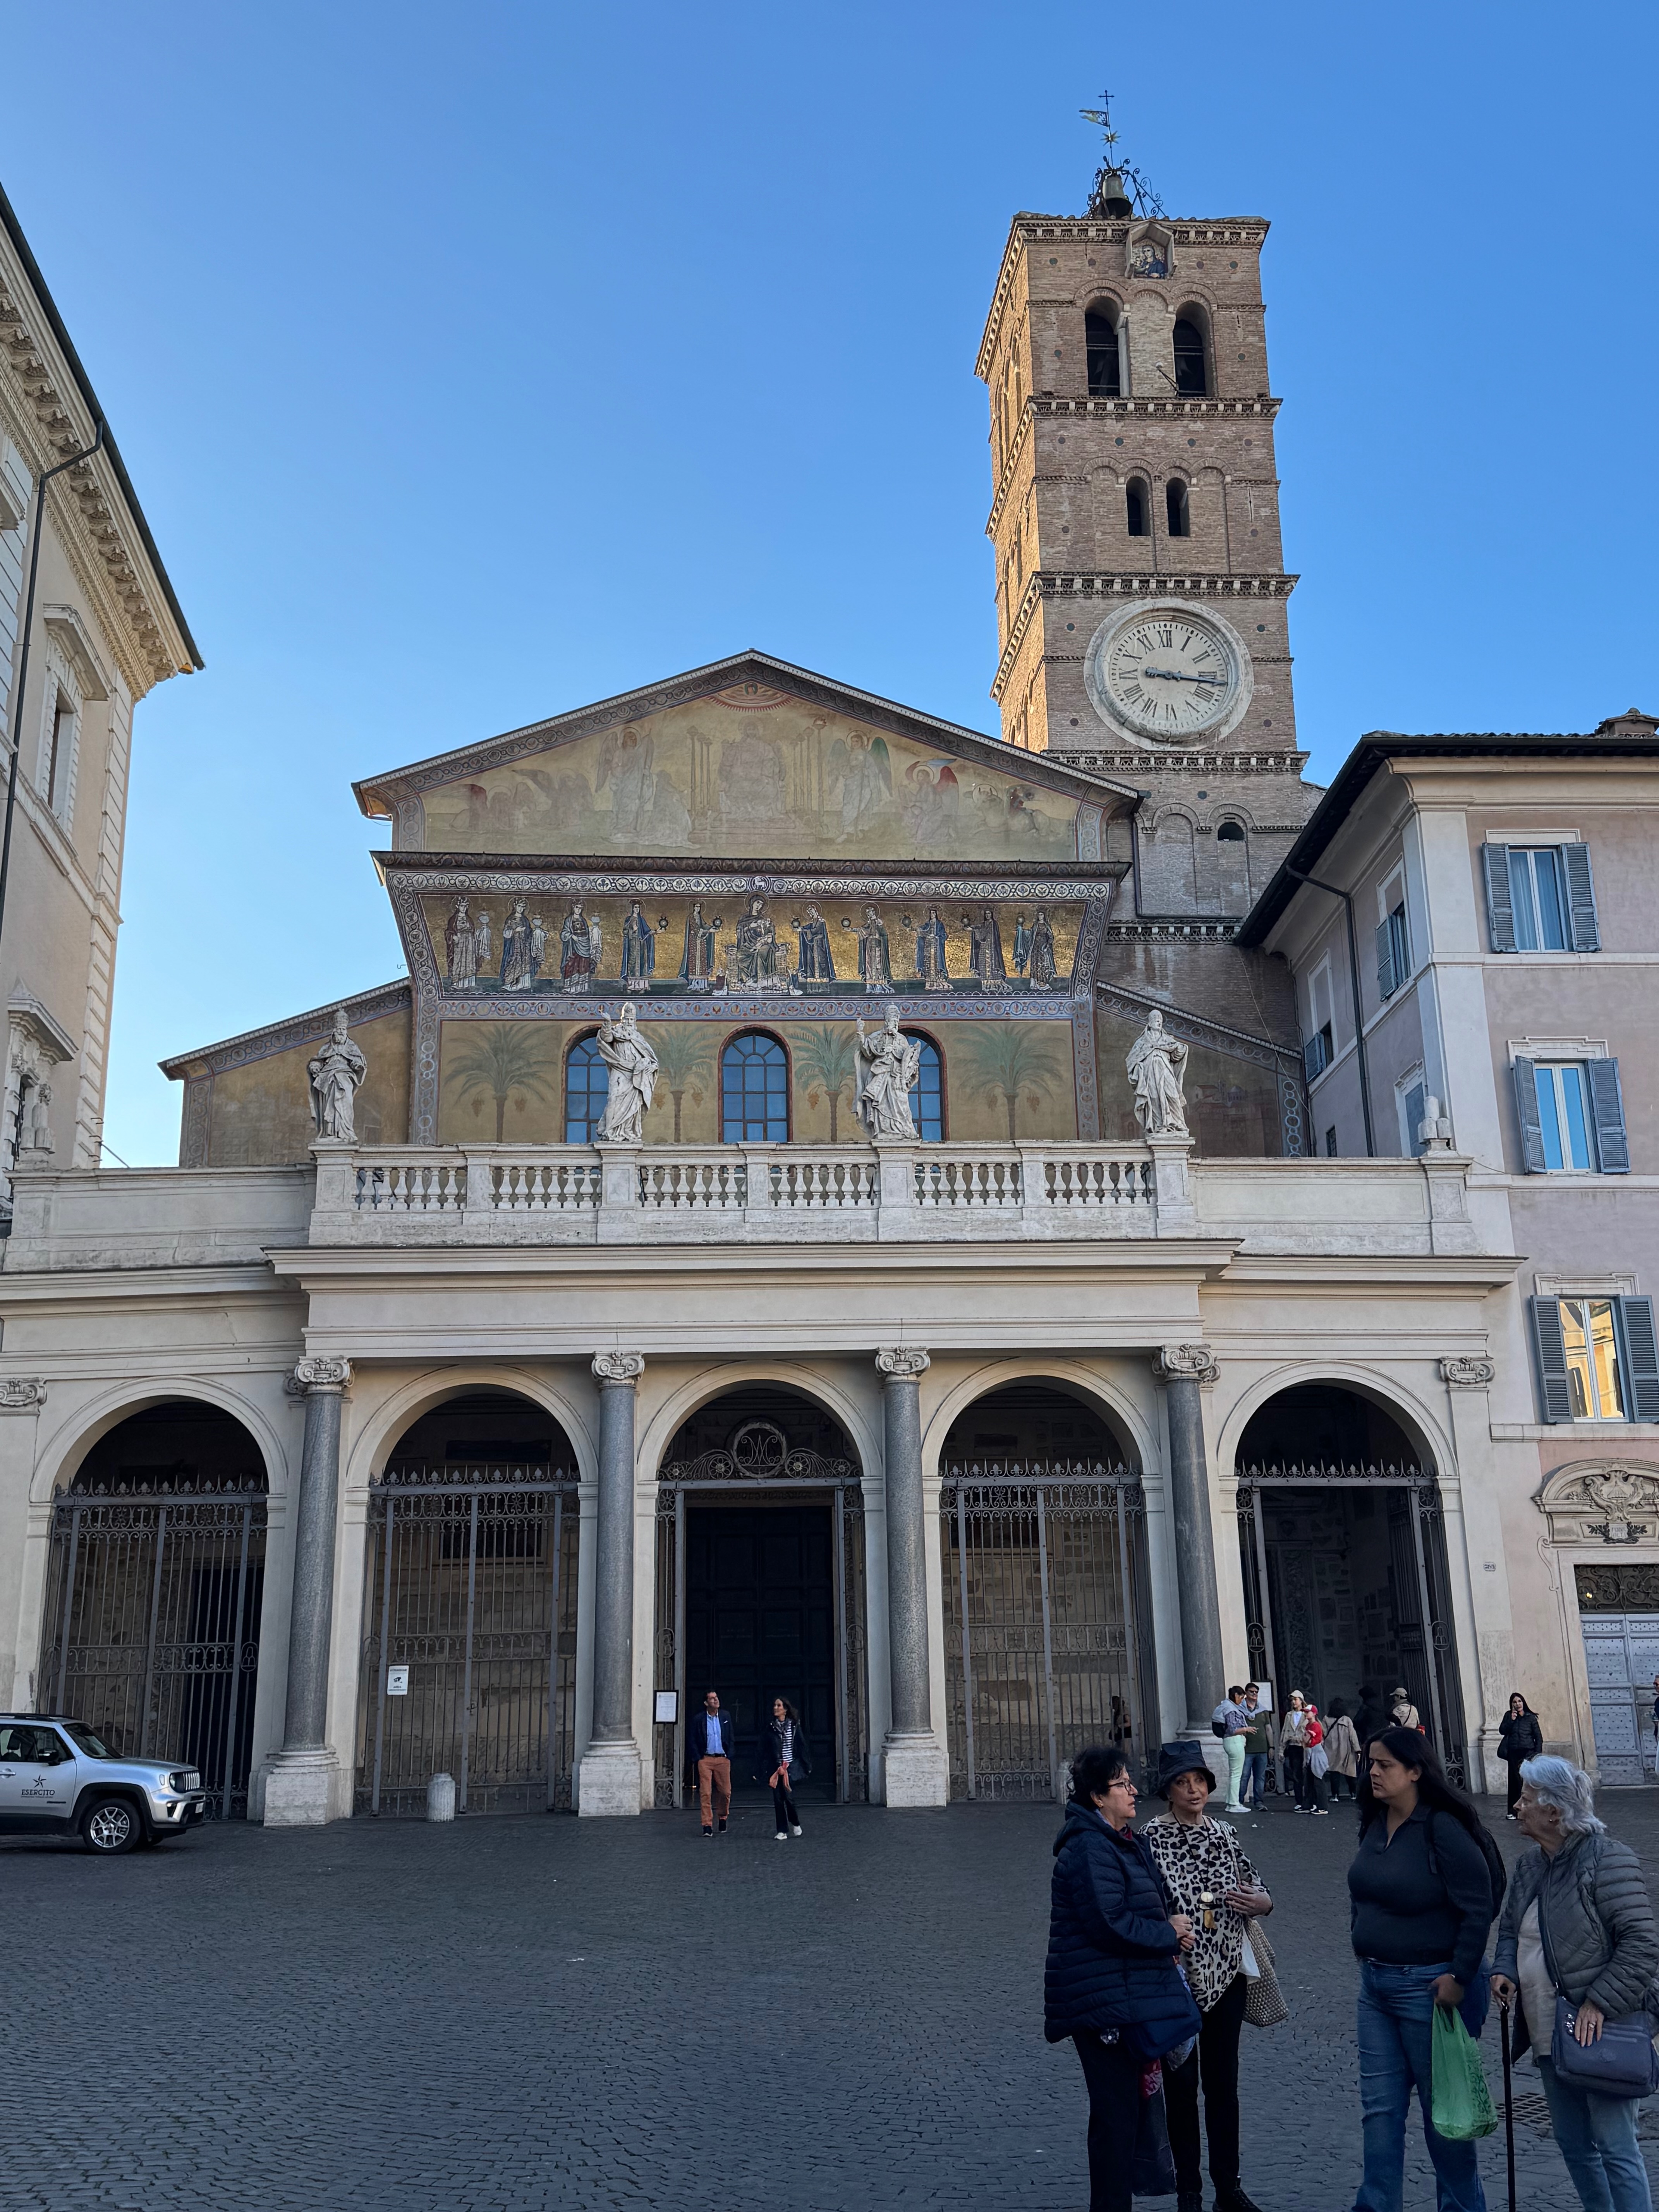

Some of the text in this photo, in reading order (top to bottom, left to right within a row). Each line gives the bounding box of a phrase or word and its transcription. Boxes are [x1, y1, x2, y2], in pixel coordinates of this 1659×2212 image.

[1137, 634, 1156, 654] XI
[1157, 630, 1173, 648] XII
[1180, 635, 1192, 652] I
[1122, 649, 1143, 664] X
[1192, 650, 1211, 664] II
[1119, 668, 1138, 680] IX
[1198, 671, 1217, 683] II
[1141, 697, 1158, 718] VII
[1165, 704, 1177, 720] VI
[1184, 700, 1200, 716] V
